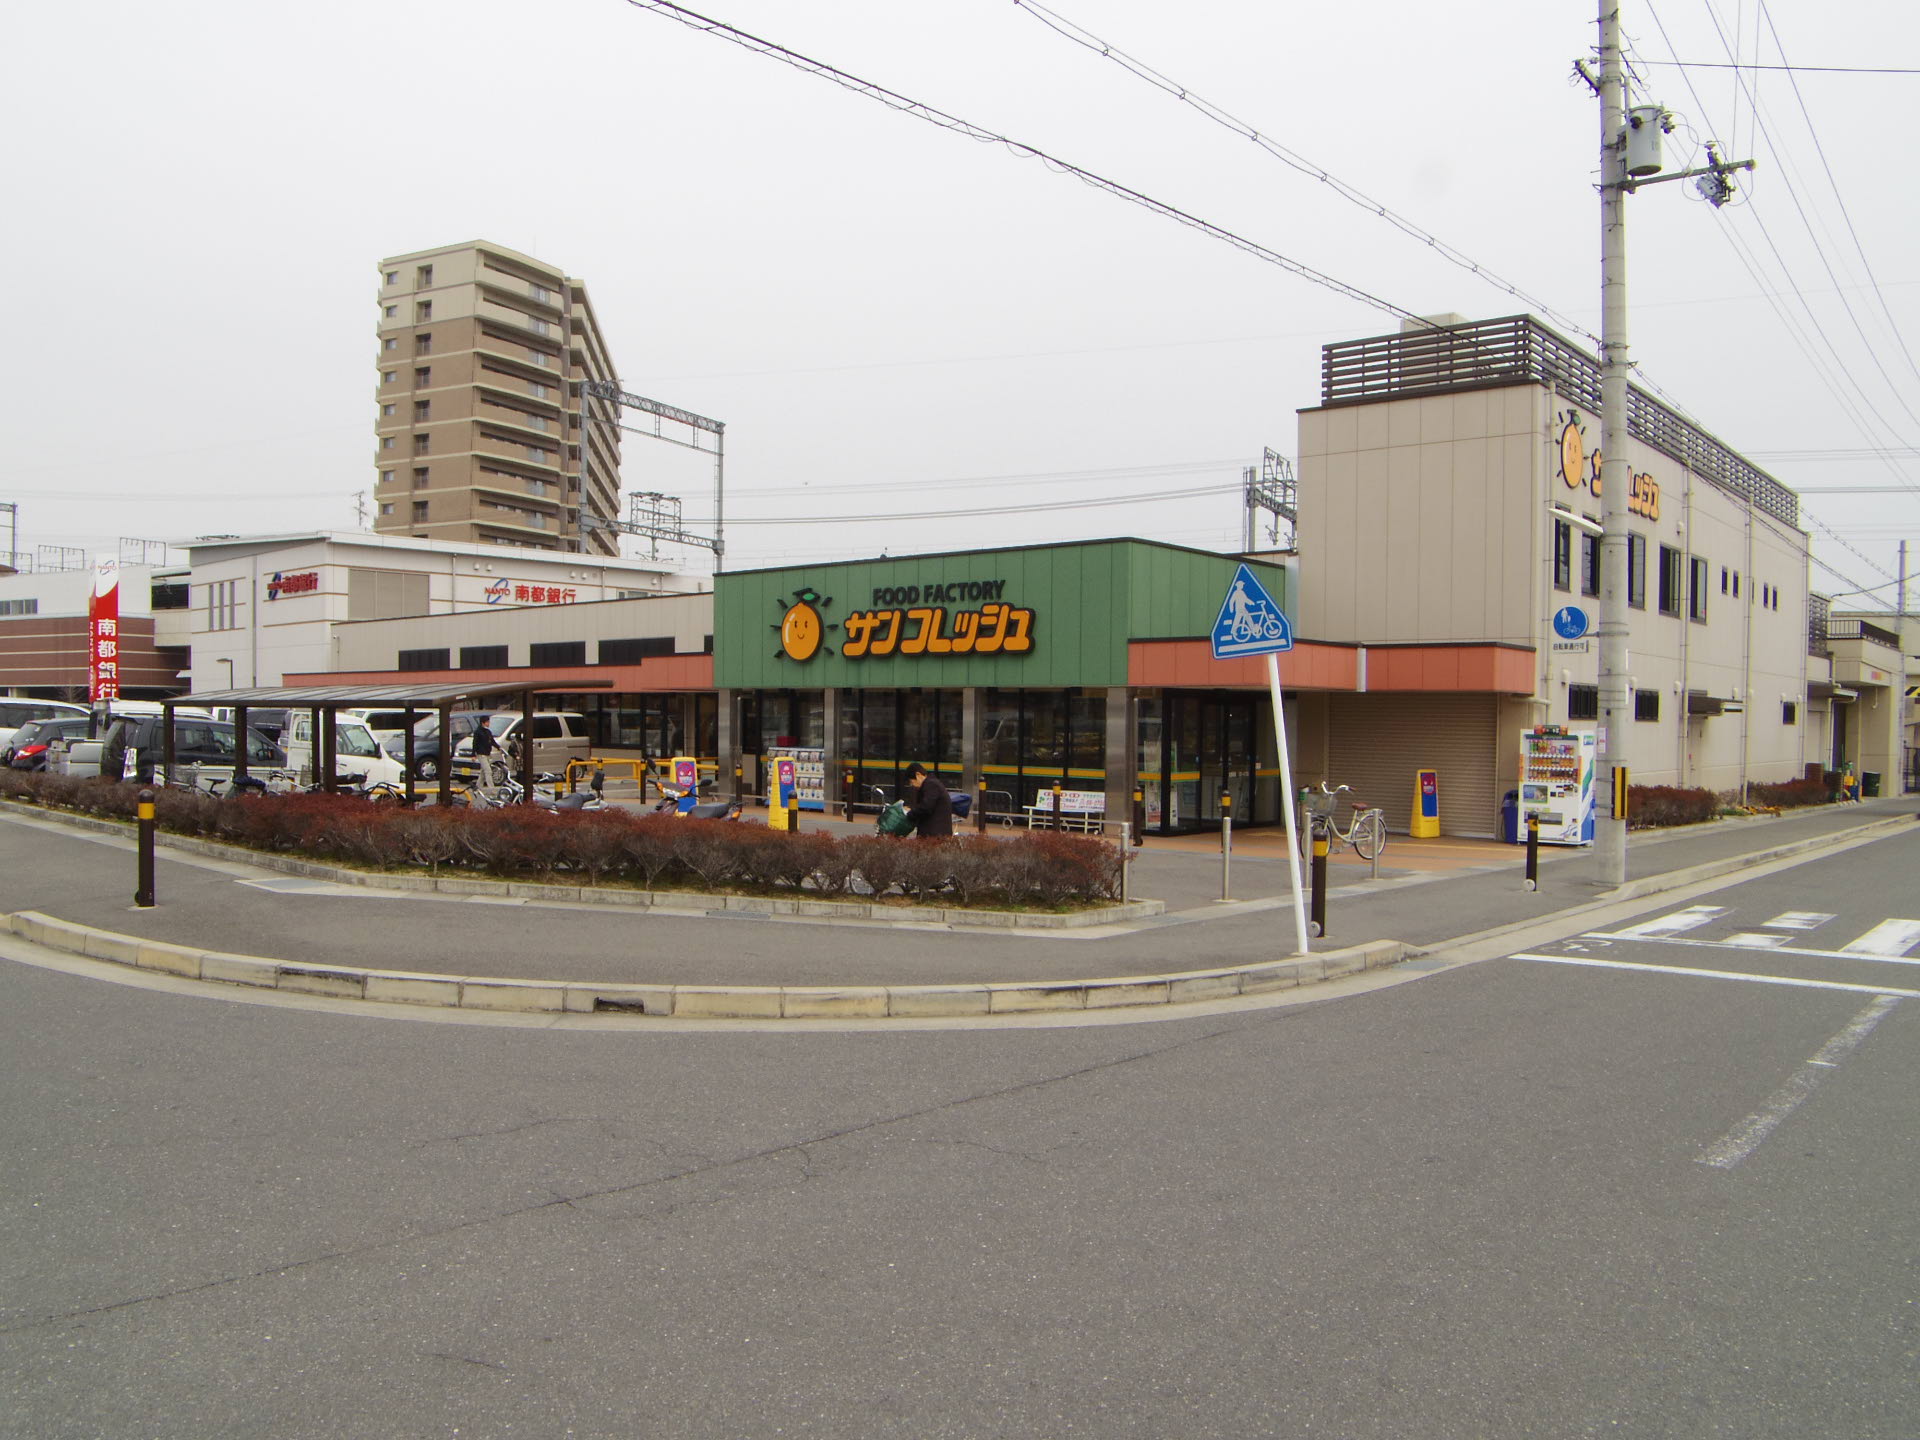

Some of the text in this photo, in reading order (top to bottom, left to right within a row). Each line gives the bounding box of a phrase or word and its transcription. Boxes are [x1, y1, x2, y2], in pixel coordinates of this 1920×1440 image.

[485, 586, 511, 596] NANTO
[515, 585, 576, 604] 南都銀行
[873, 579, 1006, 606] FOOD FACTORY
[842, 602, 1036, 660] サンフレッシュ
[97, 618, 117, 700] 南都銀行
